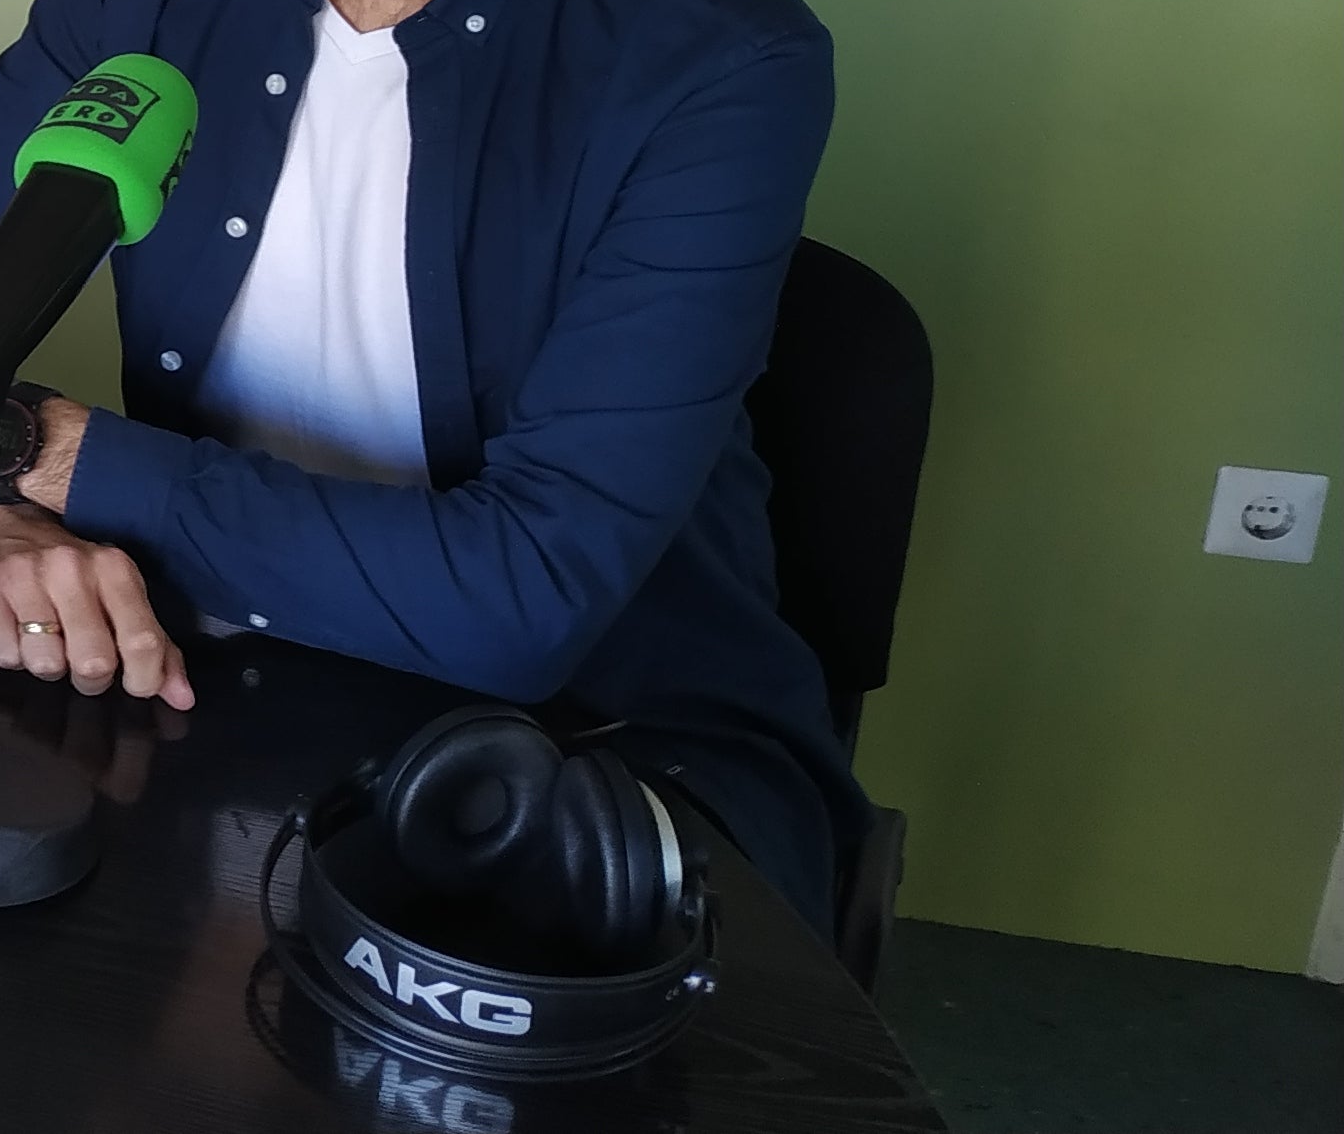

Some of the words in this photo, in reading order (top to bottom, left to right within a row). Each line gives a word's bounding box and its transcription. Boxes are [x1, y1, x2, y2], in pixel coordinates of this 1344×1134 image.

[66, 83, 128, 102] NDA
[50, 105, 116, 124] ERO
[342, 935, 533, 1036] AKG
